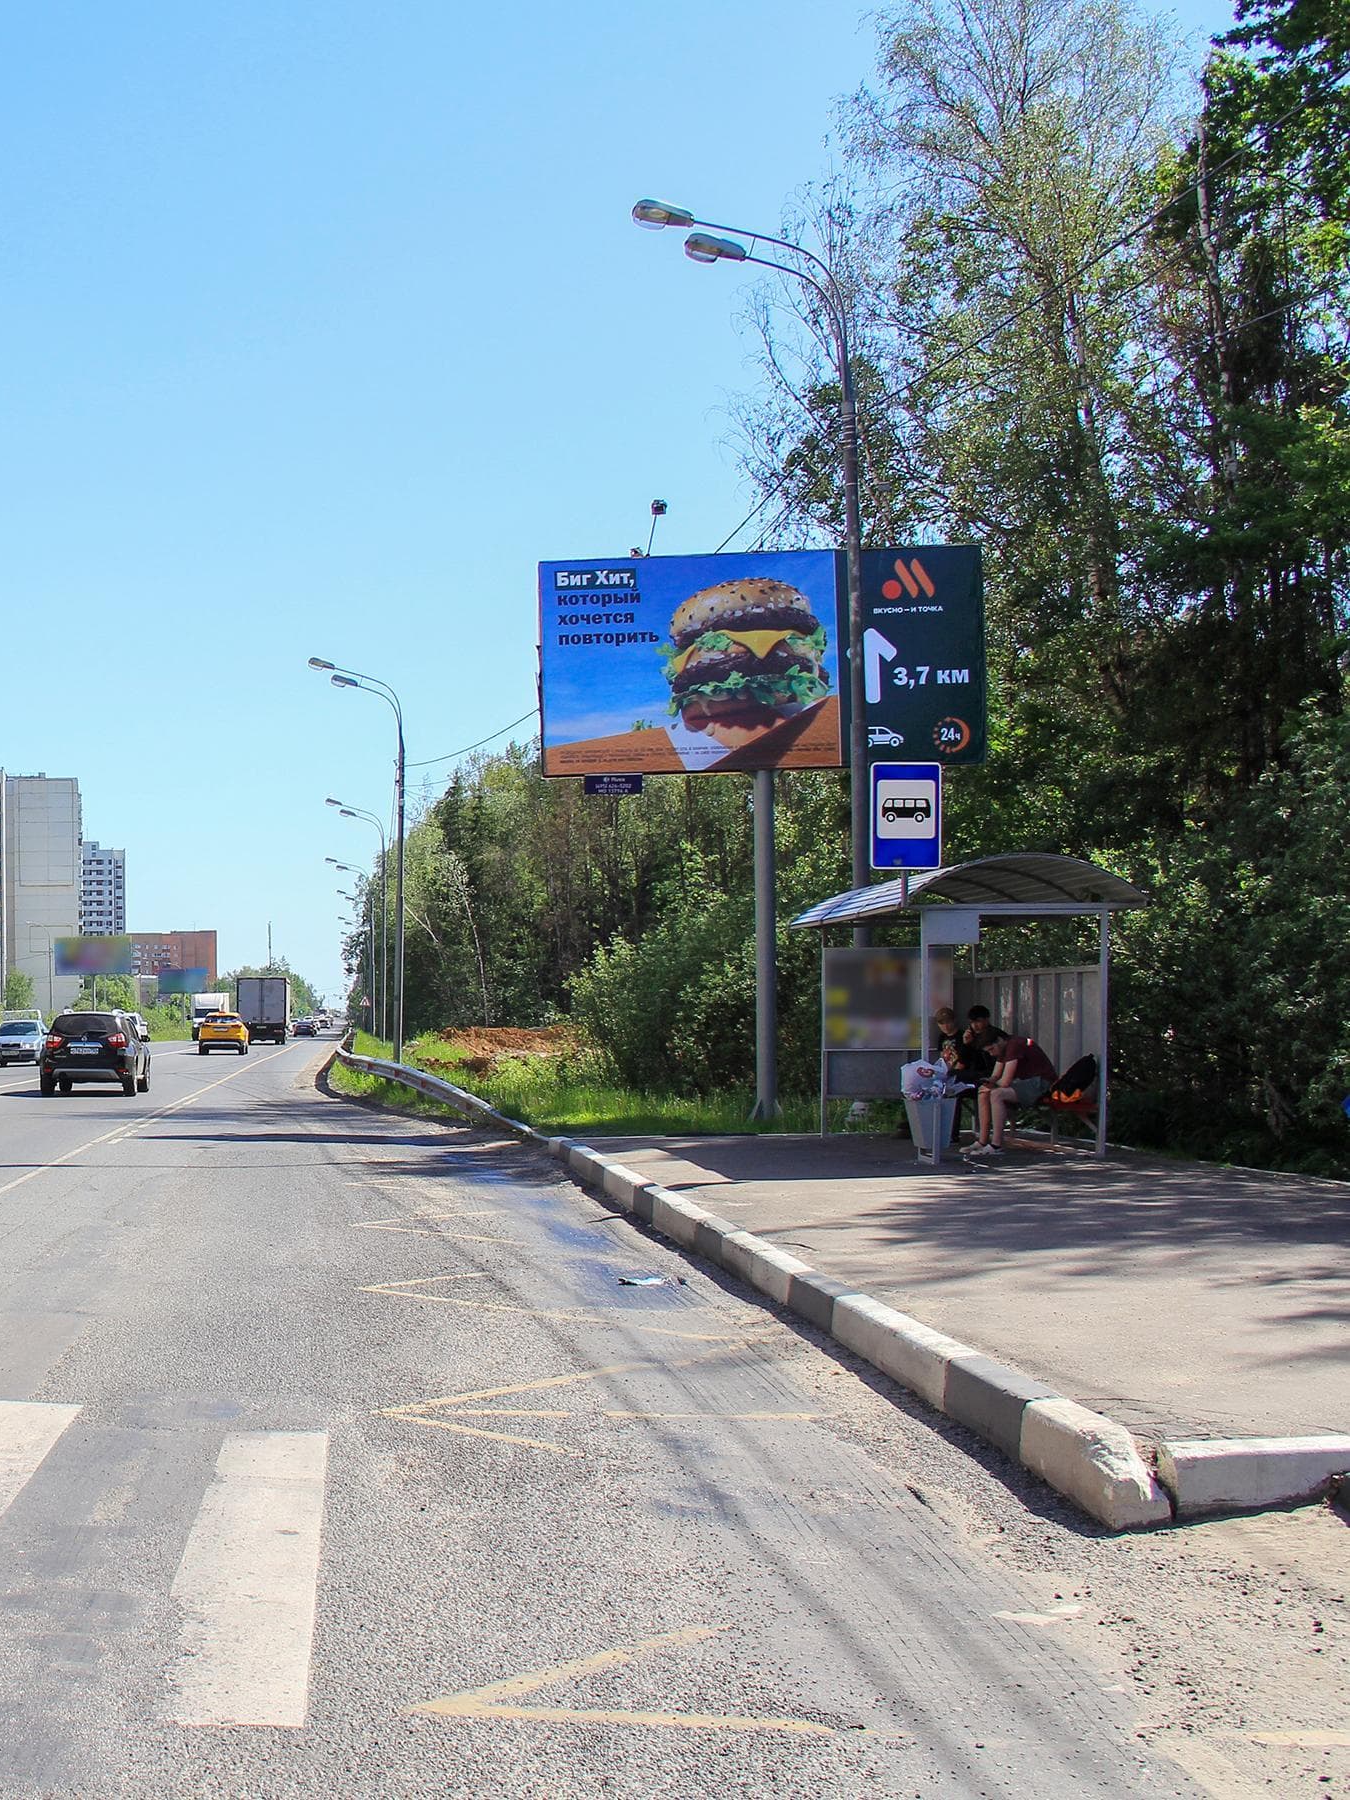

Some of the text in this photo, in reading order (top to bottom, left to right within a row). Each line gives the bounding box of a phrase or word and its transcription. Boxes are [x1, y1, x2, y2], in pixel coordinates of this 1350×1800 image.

[556, 570, 635, 588] Биг Хит,
[557, 588, 641, 607] который
[872, 607, 903, 615] ВКУСНО
[918, 605, 944, 613] ТОЧКА
[557, 612, 635, 626] хочется
[558, 631, 660, 647] повторить
[892, 665, 930, 690] 3,7
